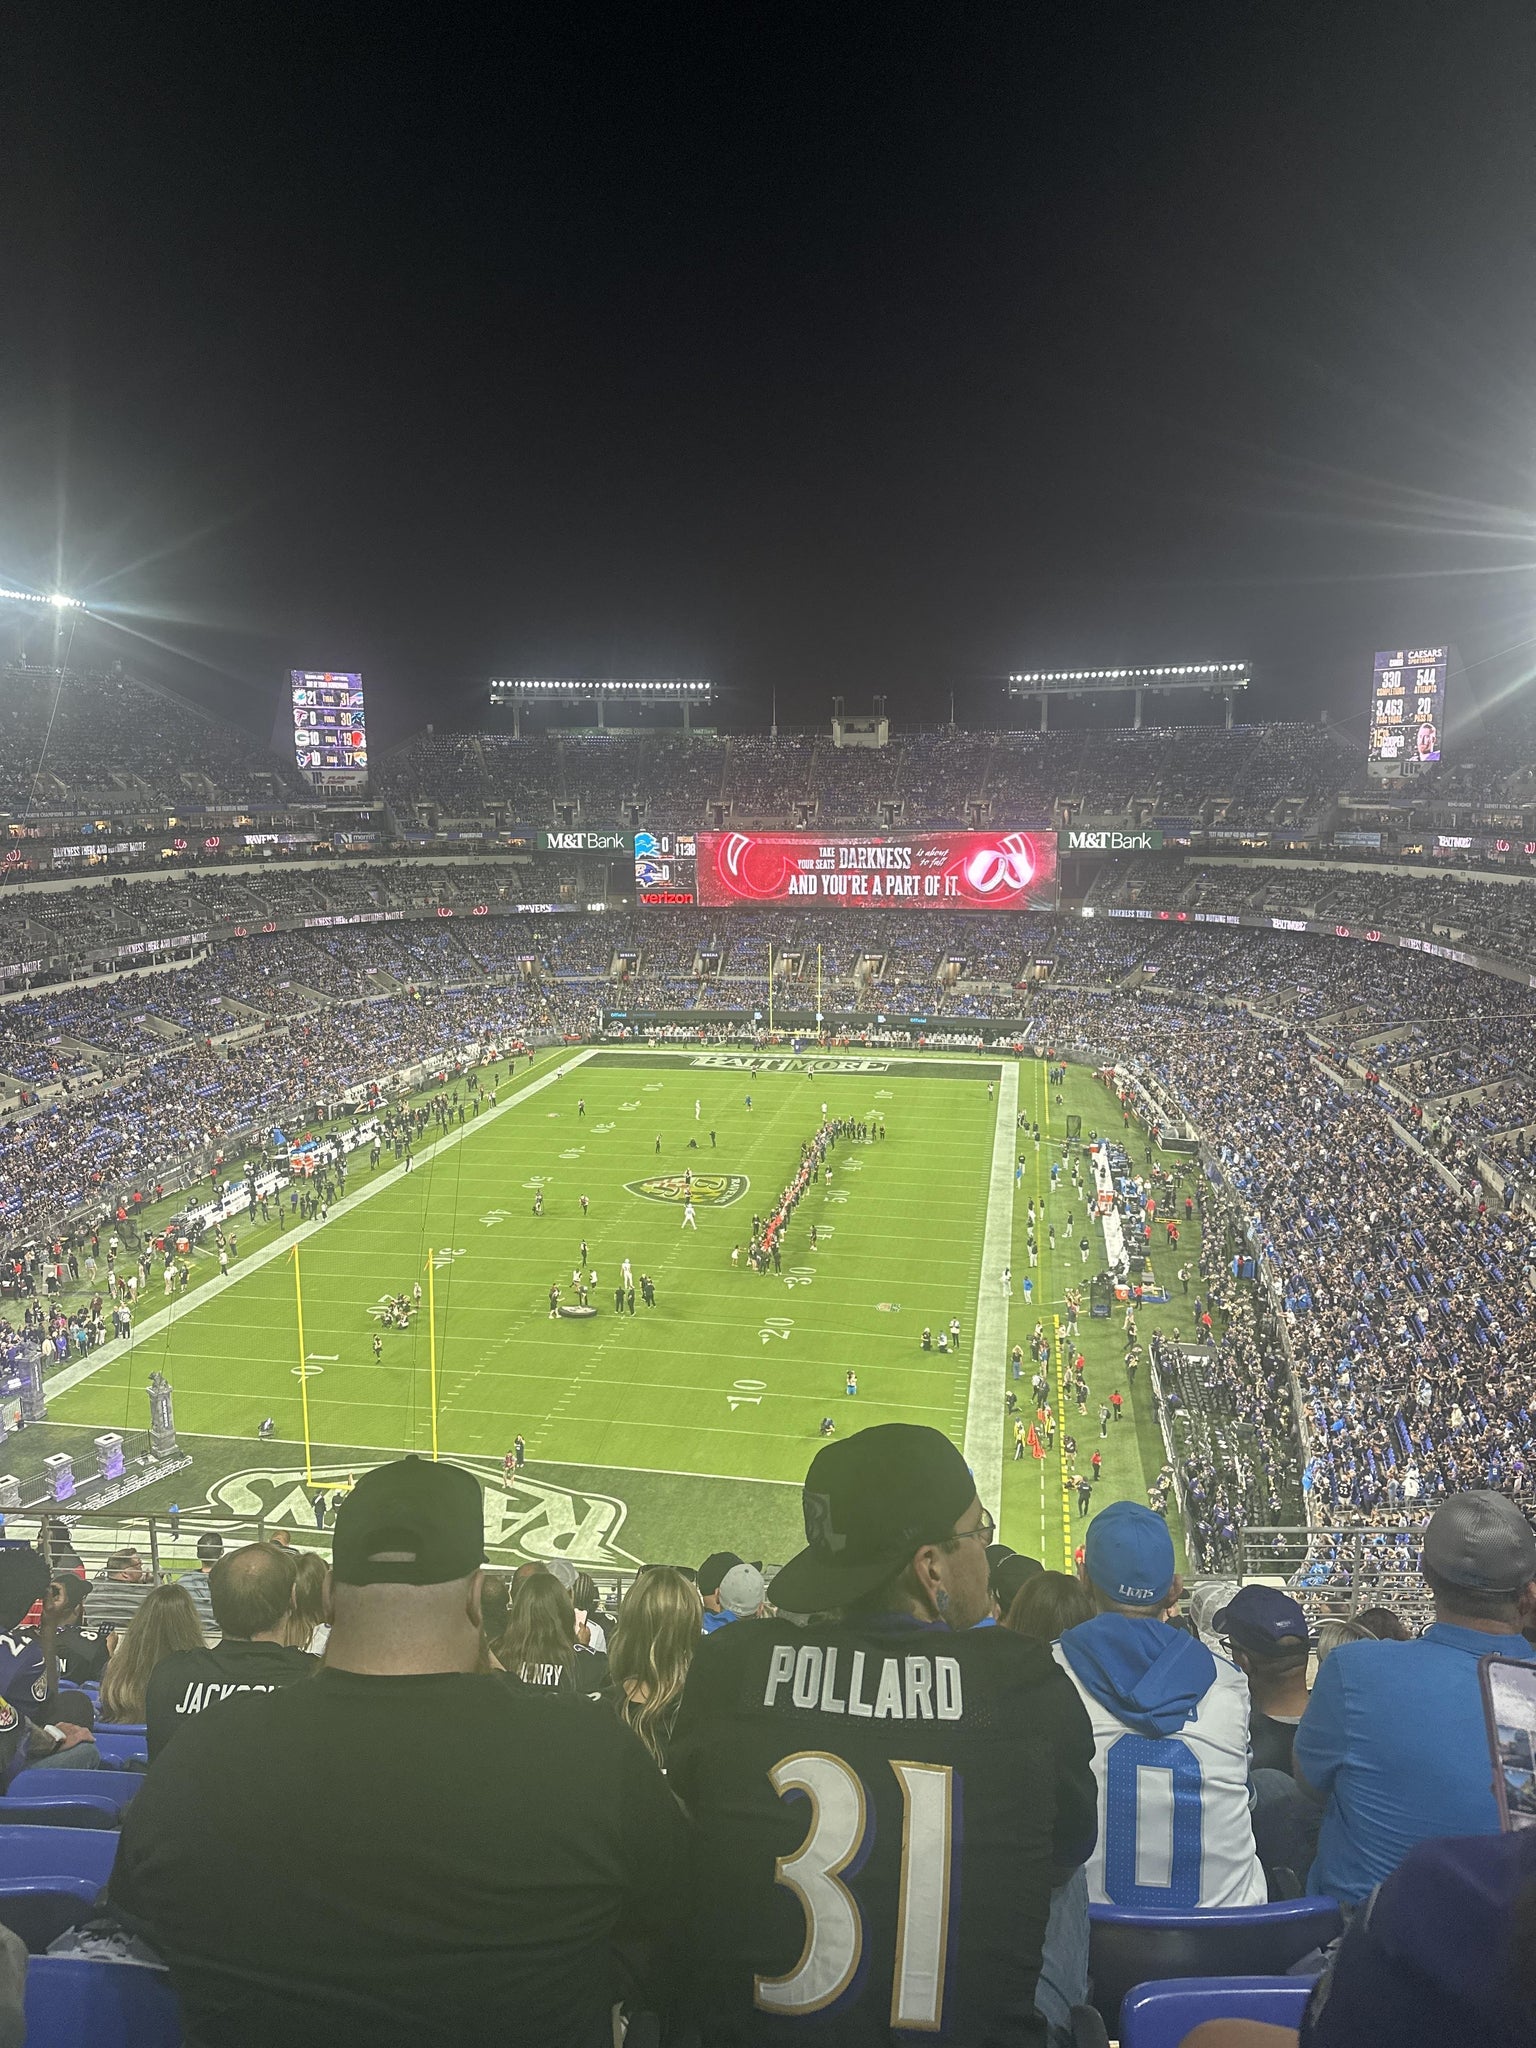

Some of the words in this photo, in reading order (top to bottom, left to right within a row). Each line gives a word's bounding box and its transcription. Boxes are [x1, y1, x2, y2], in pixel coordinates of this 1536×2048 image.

[1408, 649, 1442, 658] CAESARS
[1382, 671, 1401, 688] 330
[1416, 668, 1435, 685] 544
[307, 691, 317, 705] 21
[341, 693, 349, 706] 31
[1417, 697, 1431, 714] 20
[341, 712, 352, 726] 30
[546, 832, 586, 849] M&T
[587, 832, 624, 849] Bank
[661, 837, 669, 852] 0
[1068, 831, 1111, 849] M&T
[1112, 831, 1151, 849] Bank
[52, 845, 81, 858] DARKNESS
[819, 847, 835, 857] TAKE
[838, 847, 911, 869] DARKNESS
[662, 865, 669, 880] 0
[798, 859, 814, 869] YOUR
[815, 859, 835, 870] SEATS
[788, 874, 818, 895] AND
[821, 874, 868, 895] YOU'RE
[872, 875, 883, 896] A
[886, 875, 921, 896] PART
[924, 875, 941, 896] OF
[945, 875, 962, 896] IT.
[641, 891, 693, 904] verizon
[696, 1056, 888, 1072] BALTIMORE
[214, 1460, 620, 1566] RANS
[763, 1645, 963, 1721] POLLARD
[175, 1682, 276, 1714] JACK
[1103, 1732, 1205, 1908] 0
[753, 1750, 957, 2032] 31
